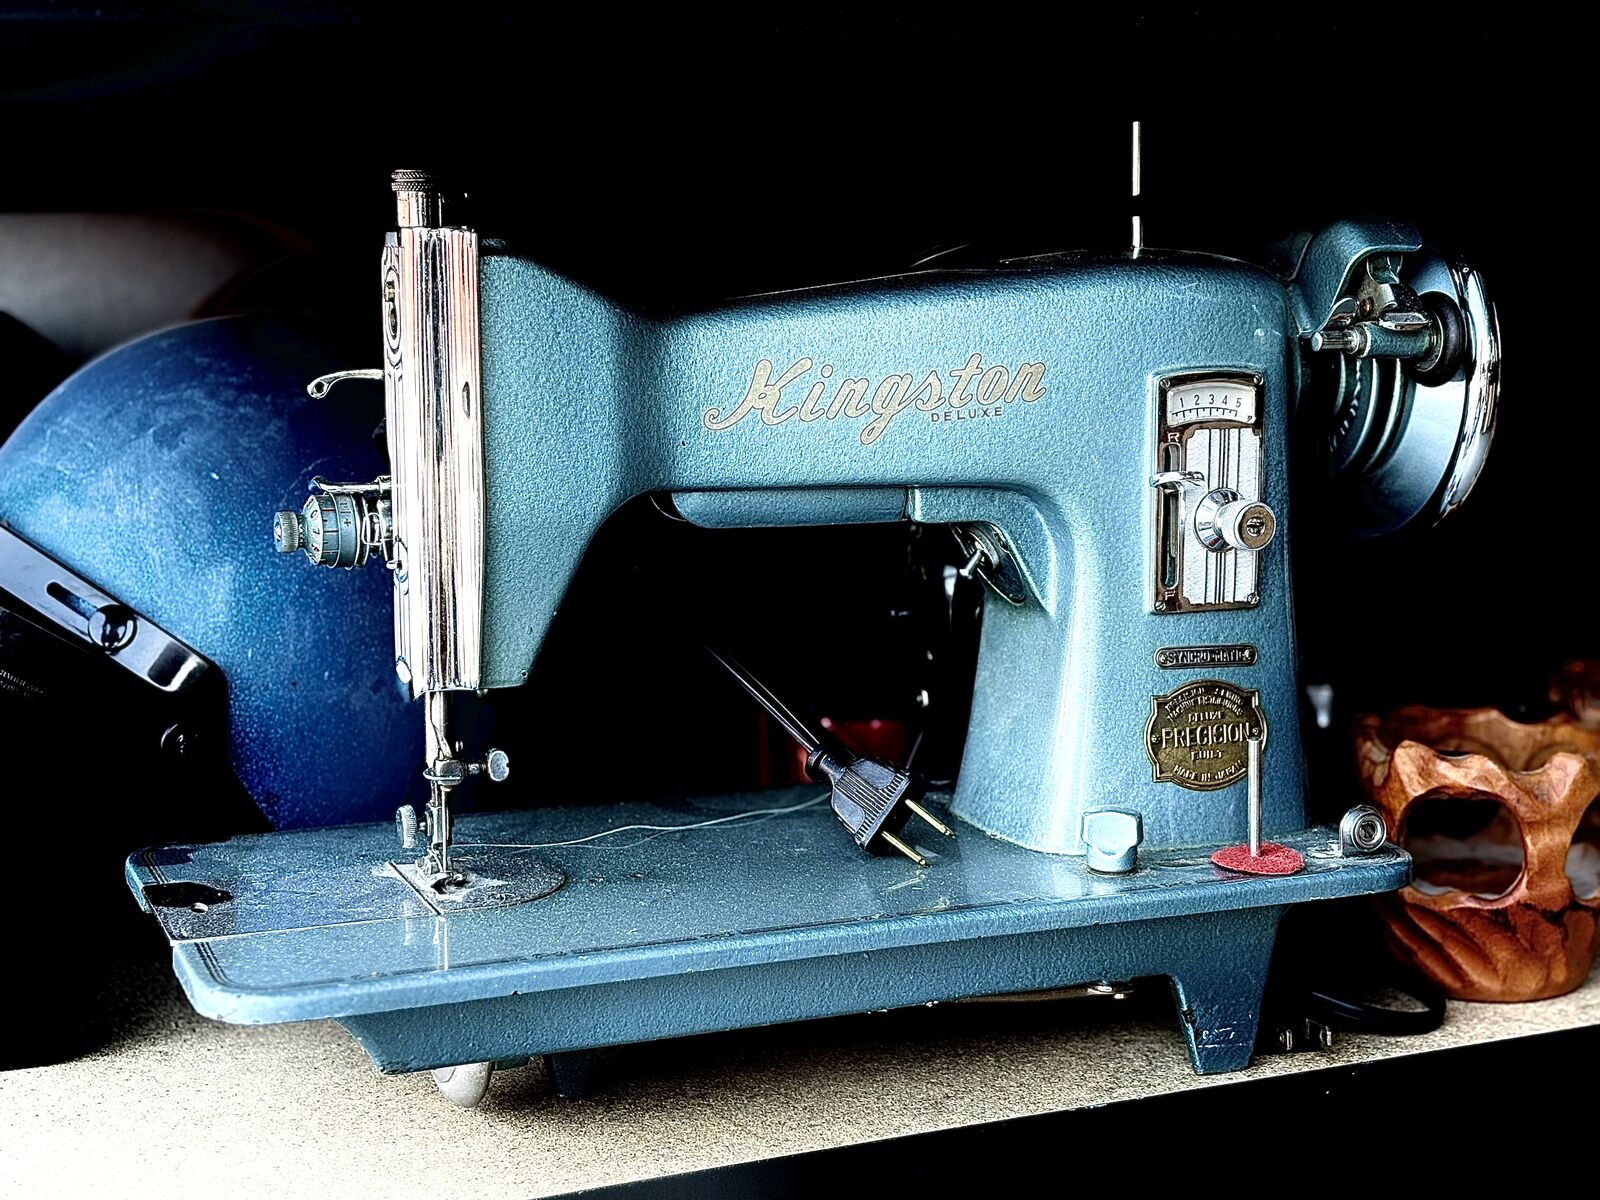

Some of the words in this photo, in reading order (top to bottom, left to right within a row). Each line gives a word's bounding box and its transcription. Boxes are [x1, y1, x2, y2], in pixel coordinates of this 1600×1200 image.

[703, 353, 1047, 445] Kingston
[1193, 394, 1200, 405] 2
[1208, 394, 1215, 405] 3
[1221, 395, 1228, 405] 4
[1235, 398, 1242, 408] 5
[930, 407, 1002, 423] DELUXE
[1167, 432, 1180, 443] R
[1164, 590, 1175, 601] F
[1161, 722, 1250, 749] PRECISION
[1174, 765, 1198, 779] MADE
[1215, 760, 1243, 779] JAPAN
